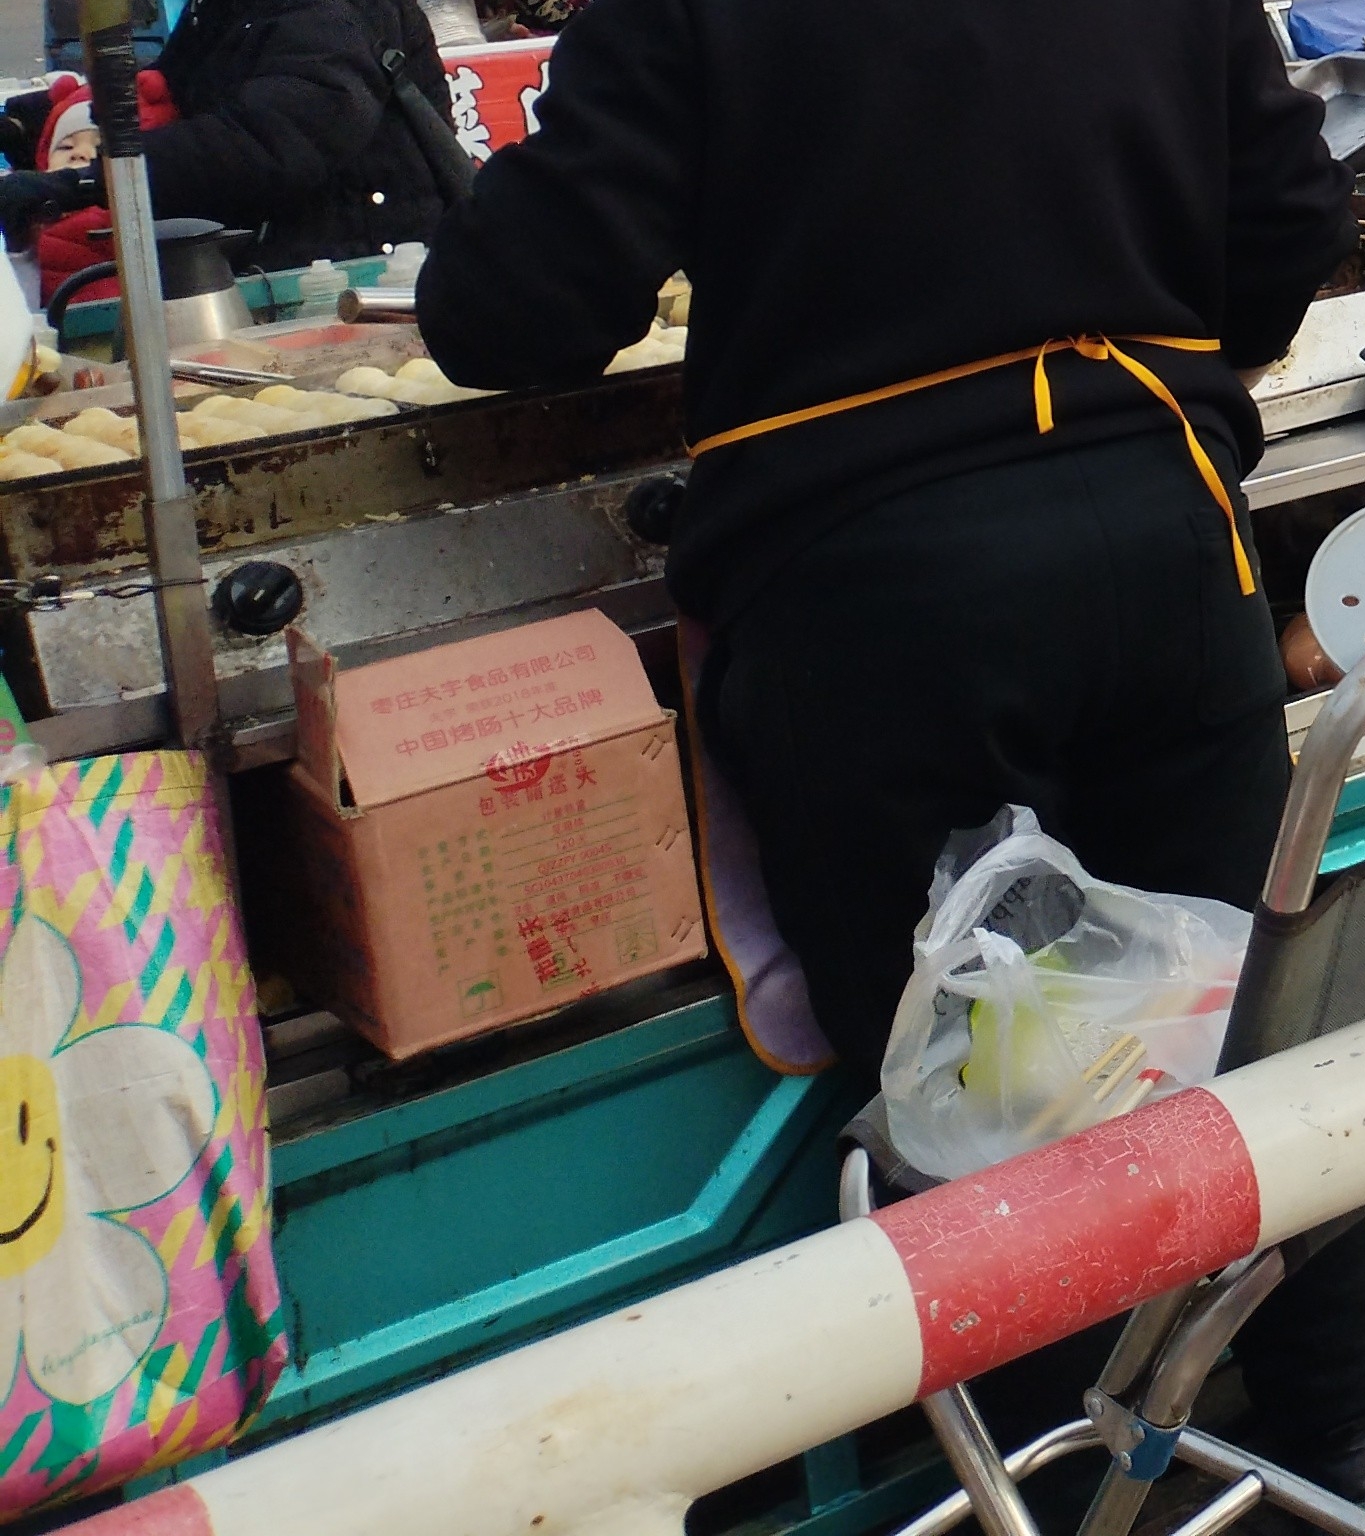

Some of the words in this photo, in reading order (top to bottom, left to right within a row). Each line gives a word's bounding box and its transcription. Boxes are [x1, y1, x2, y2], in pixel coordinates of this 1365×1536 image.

[395, 687, 605, 757] 中国烤肠十大品牌
